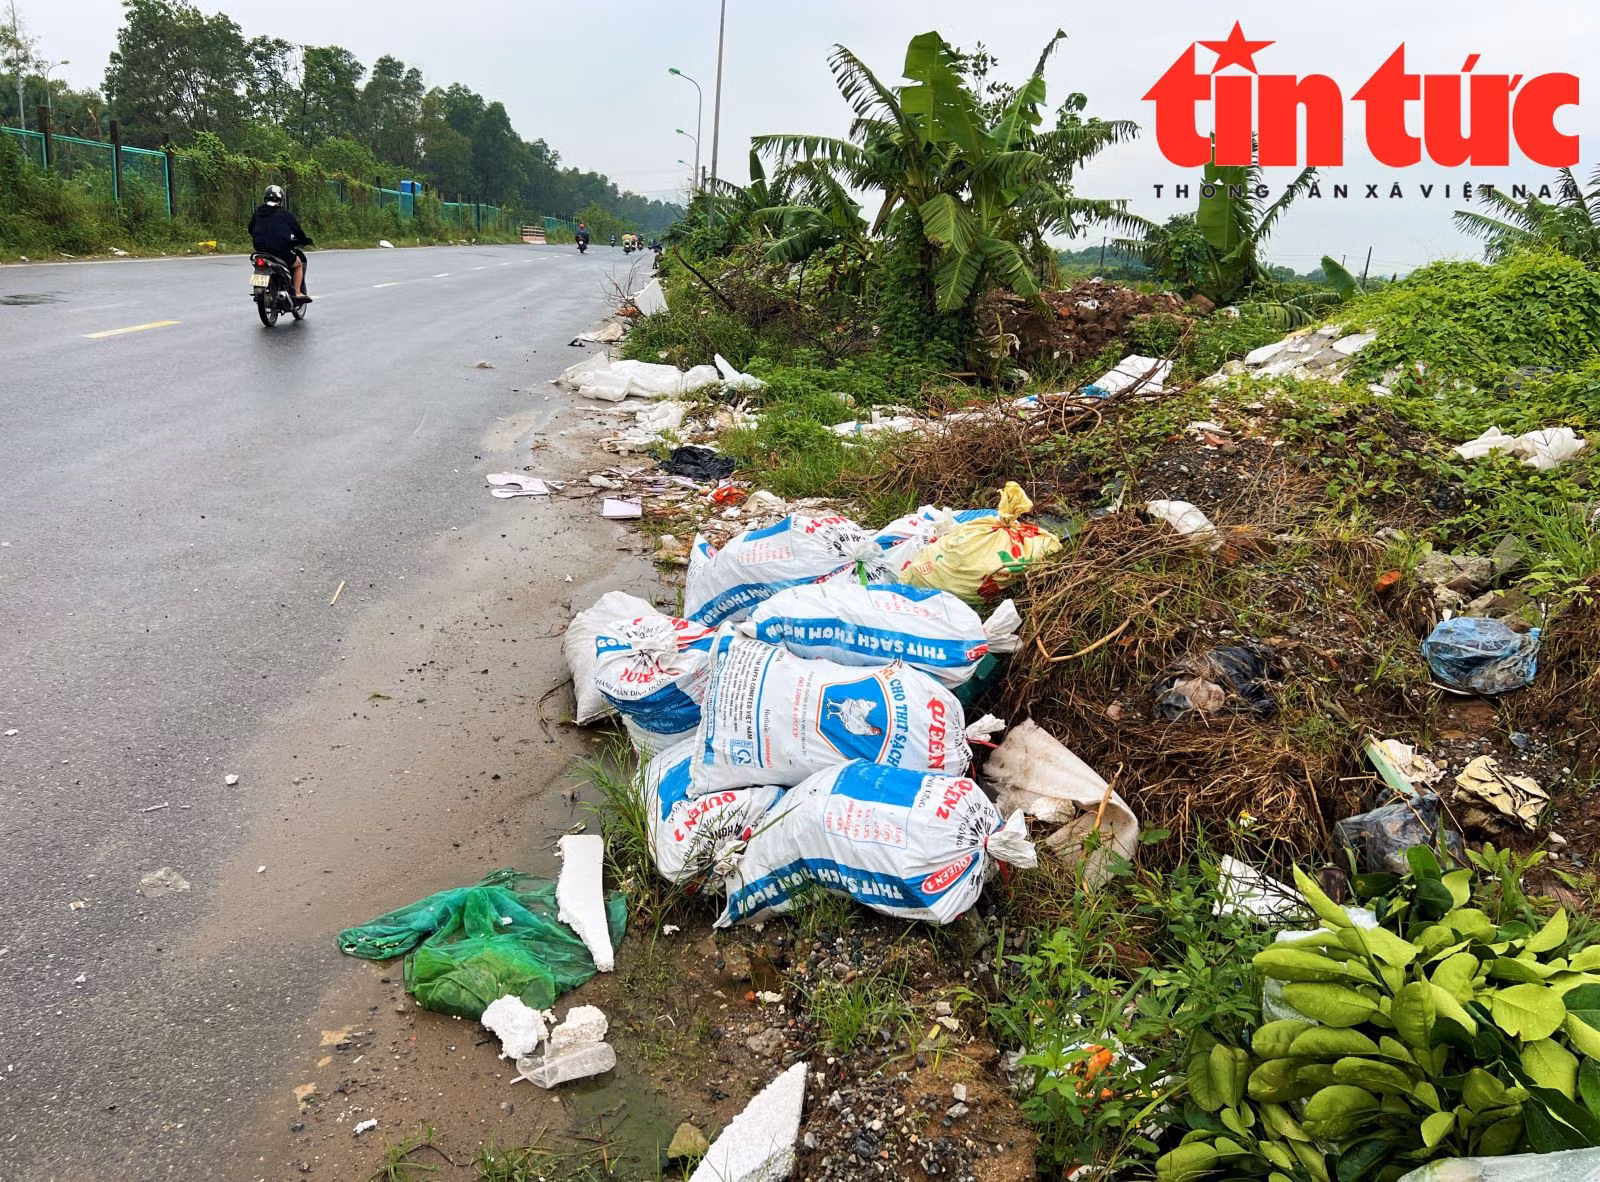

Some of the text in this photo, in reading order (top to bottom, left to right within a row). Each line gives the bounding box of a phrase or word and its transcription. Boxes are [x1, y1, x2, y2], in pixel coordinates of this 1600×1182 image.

[809, 625, 855, 645] THƠM
[858, 634, 904, 654] SẠCH
[908, 641, 947, 660] THỊT
[890, 678, 906, 701] CHO
[893, 703, 909, 733] THỊT
[936, 806, 950, 820] 2
[928, 859, 968, 890] QUEEN 2
